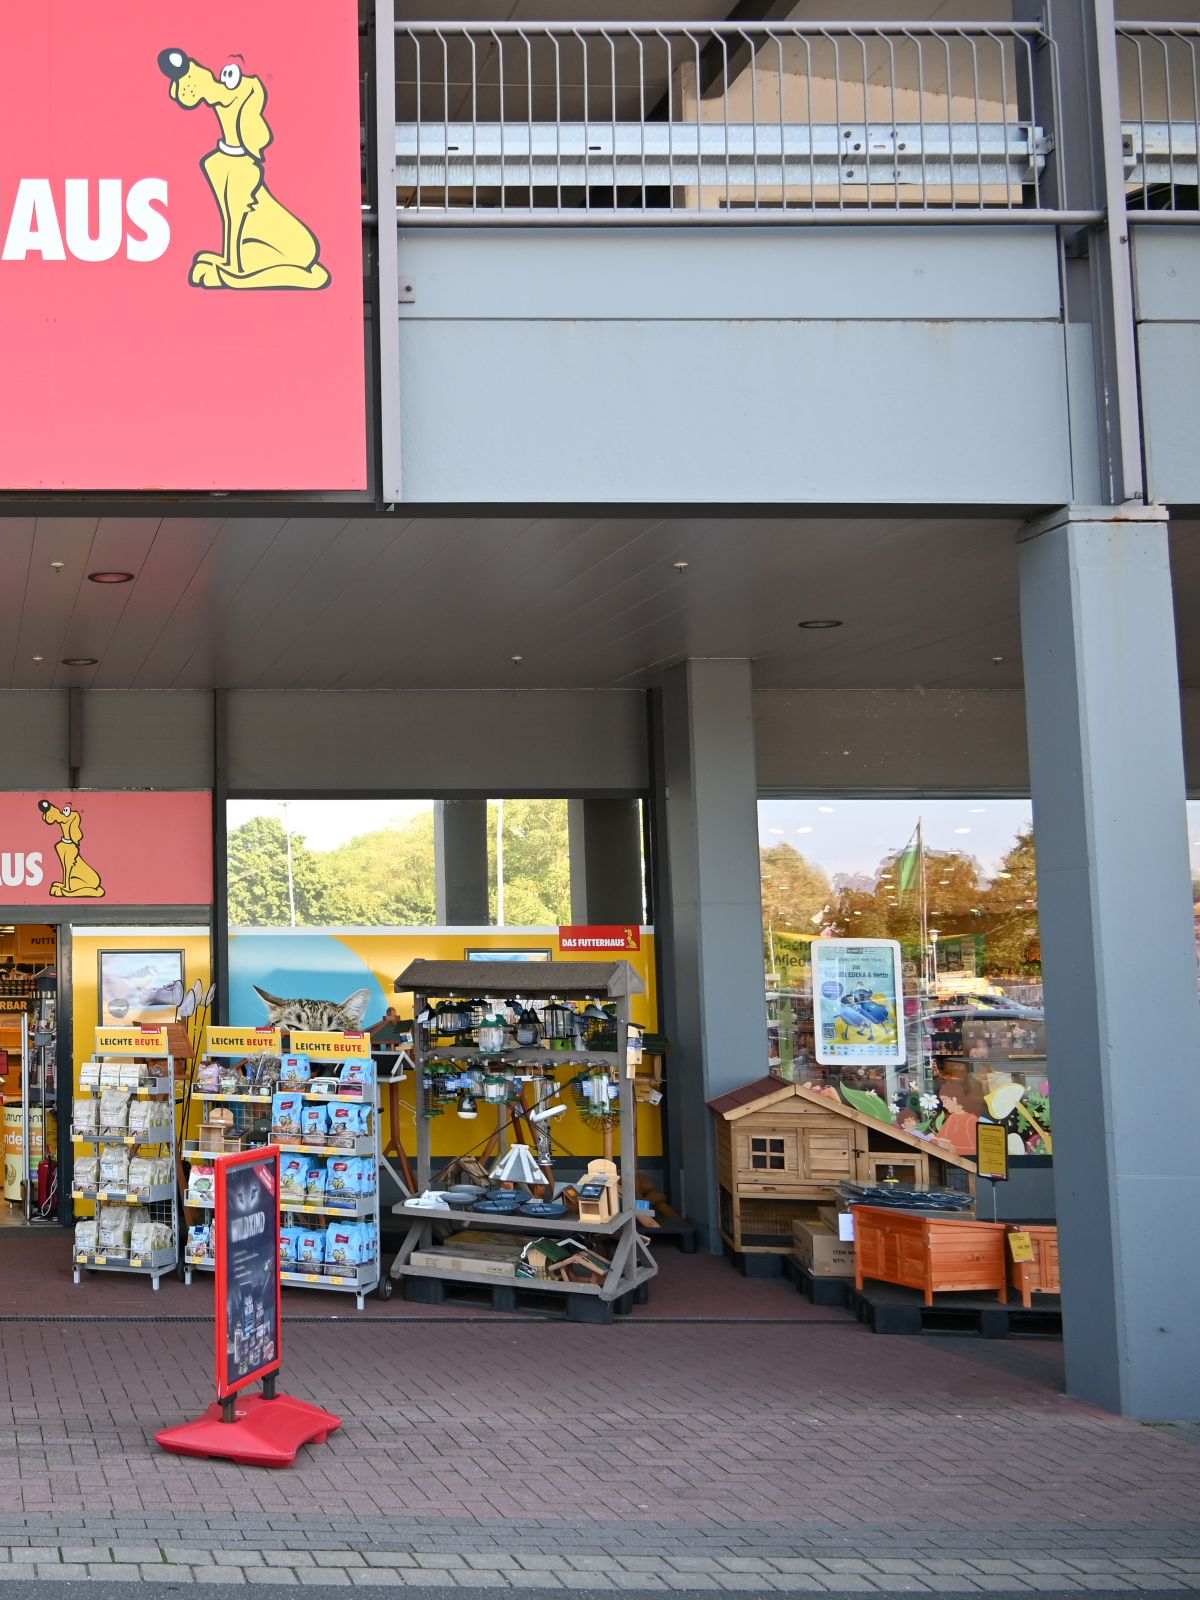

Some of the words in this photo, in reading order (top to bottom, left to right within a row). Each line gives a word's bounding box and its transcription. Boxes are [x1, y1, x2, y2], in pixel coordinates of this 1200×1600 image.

[561, 938, 577, 947] DAS
[577, 938, 625, 947] FUTTERHAUS
[100, 1038, 132, 1046] LEICHTE
[135, 1038, 163, 1046] BEUTE.
[211, 1037, 244, 1046] LEICHTE
[246, 1038, 276, 1047] BEUTE.
[295, 1042, 331, 1051] LEICHTE
[334, 1043, 365, 1052] BEUTE.
